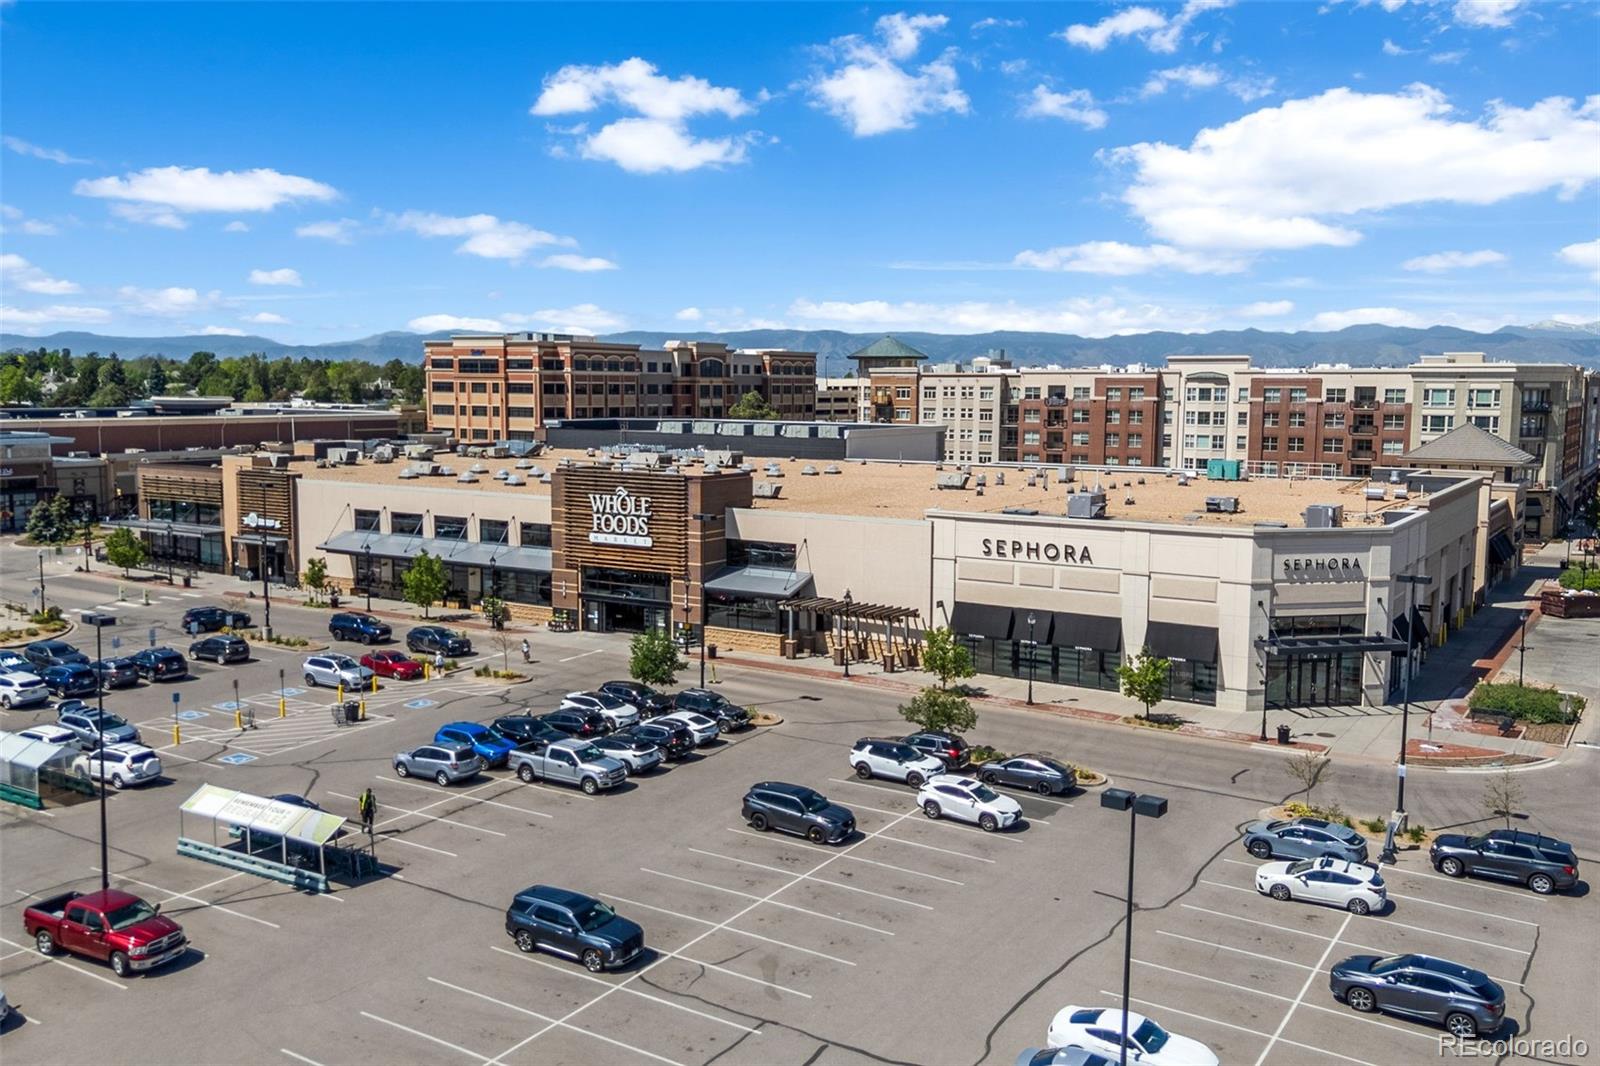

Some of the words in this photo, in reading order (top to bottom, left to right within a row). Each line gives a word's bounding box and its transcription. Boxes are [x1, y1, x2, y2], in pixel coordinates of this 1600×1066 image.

[588, 487, 652, 516] WHOLE
[592, 513, 648, 535] FOODS
[593, 535, 647, 544] MARKET
[982, 538, 1093, 565] SEPHORA
[1283, 558, 1361, 571] SEPHORA
